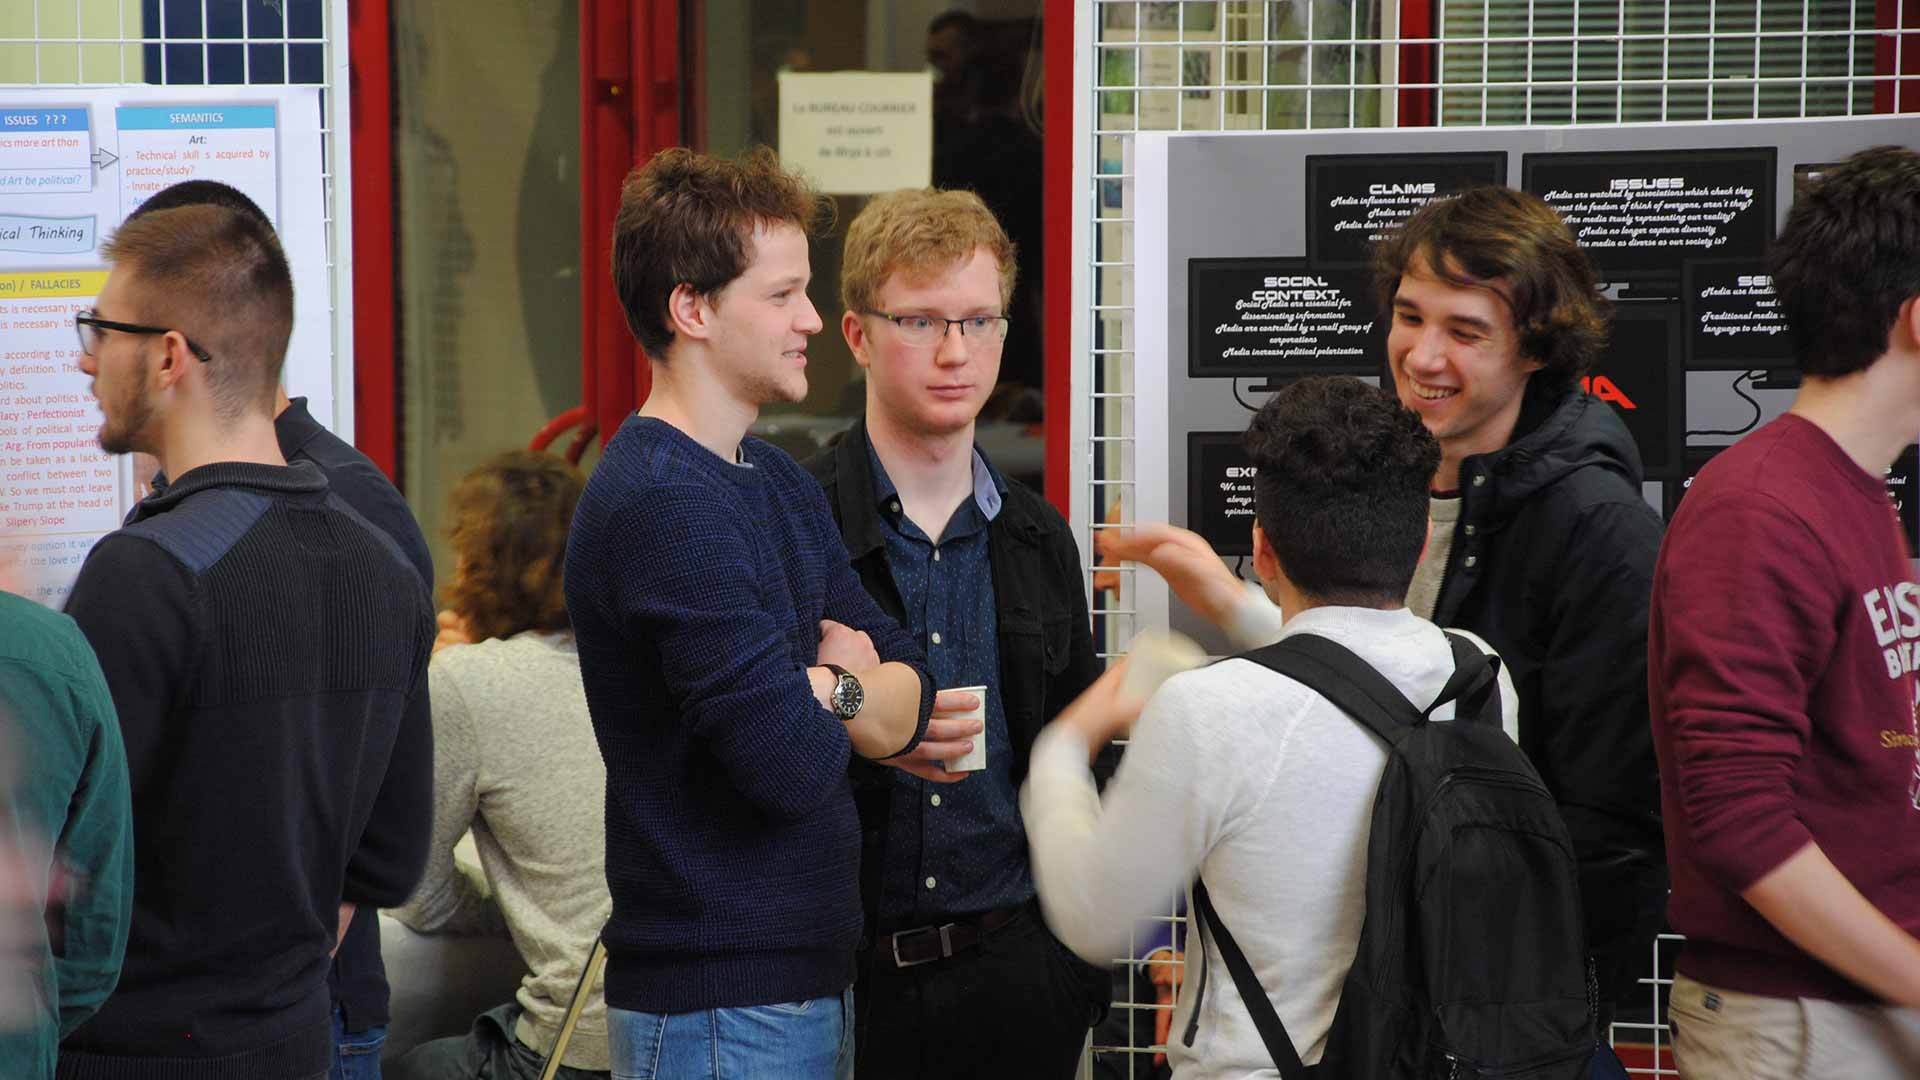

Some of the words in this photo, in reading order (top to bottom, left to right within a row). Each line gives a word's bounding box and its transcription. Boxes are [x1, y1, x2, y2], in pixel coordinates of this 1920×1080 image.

[4, 115, 38, 126] ISSUES
[169, 113, 224, 123] SEMANTICS
[14, 139, 39, 147] more
[41, 138, 55, 147] art
[57, 136, 79, 147] than
[188, 135, 208, 145] Art:
[136, 151, 176, 161] Technical
[182, 150, 200, 160] skill
[215, 150, 254, 162] acquired
[259, 149, 270, 160] by
[7, 176, 21, 185] Art
[25, 175, 36, 185] be
[38, 175, 82, 187] political?
[132, 182, 161, 191] Innate
[1610, 177, 1684, 190] ISSUES
[1369, 183, 1436, 195] CLAIMS
[1544, 189, 1573, 201] Media
[1590, 188, 1623, 198] watched
[1624, 188, 1634, 200] by
[1635, 188, 1684, 197] associations
[1685, 186, 1709, 196] which
[1710, 186, 1734, 195] check
[1735, 185, 1754, 198] they
[1330, 195, 1359, 207] Media
[1360, 195, 1396, 208] influence
[1397, 195, 1410, 204] the
[1411, 197, 1427, 206] way
[1574, 202, 1588, 211] the
[1620, 200, 1631, 213] of
[1630, 200, 1652, 210] think
[1653, 199, 1665, 213] of
[1703, 198, 1729, 208] aren't
[1729, 198, 1753, 211] they?
[1368, 208, 1396, 219] Media
[1562, 214, 1581, 224] Are
[1583, 213, 1607, 223] media
[1634, 213, 1687, 225] representing
[1703, 210, 1736, 223] reality?
[1334, 220, 1362, 231] Media
[1364, 220, 1384, 229] don't
[1579, 226, 1608, 238] Media
[1621, 225, 1648, 237] longer
[1648, 226, 1680, 237] capture
[1681, 224, 1717, 236] diversity
[30, 225, 84, 242] Thinking
[1590, 238, 1616, 247] media
[1628, 238, 1656, 247] diverse
[1685, 238, 1713, 249] society
[1714, 236, 1727, 245] is?
[30, 279, 81, 289] FALLACIES
[1264, 276, 1328, 287] SOCIAL
[1252, 290, 1340, 301] CONTEXT
[1701, 286, 1731, 298] Media
[1235, 299, 1261, 310] Social
[1261, 300, 1289, 310] Media
[1305, 298, 1339, 307] essential
[1338, 297, 1352, 310] for
[1756, 299, 1777, 307] read
[22, 304, 67, 316] necessary
[71, 303, 81, 312] to
[1241, 311, 1295, 323] disseminating
[1295, 310, 1346, 322] informations
[1701, 310, 1752, 322] Traditional
[1752, 310, 1778, 319] media
[13, 320, 58, 331] necessary
[64, 318, 74, 328] to
[1215, 323, 1243, 334] Media
[1259, 322, 1298, 332] controlled
[1298, 322, 1309, 334] by
[1316, 322, 1339, 331] small
[1337, 324, 1361, 334] group
[1362, 321, 1374, 334] of
[1703, 323, 1741, 336] language
[1742, 324, 1751, 332] to
[1752, 322, 1782, 335] change
[1269, 336, 1318, 346] corporations
[4, 350, 51, 361] according
[55, 349, 65, 358] to
[1222, 347, 1251, 358] Media
[1251, 348, 1284, 356] increase
[1283, 346, 1318, 358] political
[1315, 346, 1364, 358] polarization
[14, 395, 42, 405] about
[46, 392, 79, 405] politics
[27, 408, 85, 420] Perfectionist
[22, 425, 32, 434] of
[36, 423, 72, 435] political
[27, 440, 50, 450] From
[10, 455, 22, 465] be
[26, 454, 51, 465] taken
[55, 455, 66, 463] as
[80, 453, 98, 463] lack
[7, 470, 41, 481] conflict
[47, 468, 87, 480] between
[94, 466, 112, 477] two
[10, 487, 21, 496] So
[25, 486, 38, 495] we
[42, 484, 66, 494] must
[69, 483, 85, 493] not
[88, 482, 112, 492] leave
[1220, 482, 1236, 491] We
[1237, 484, 1252, 492] can
[14, 501, 45, 512] Trump
[46, 499, 56, 509] at
[59, 498, 75, 508] the
[78, 497, 101, 508] head
[1226, 495, 1252, 506] always
[40, 514, 65, 526] Slope
